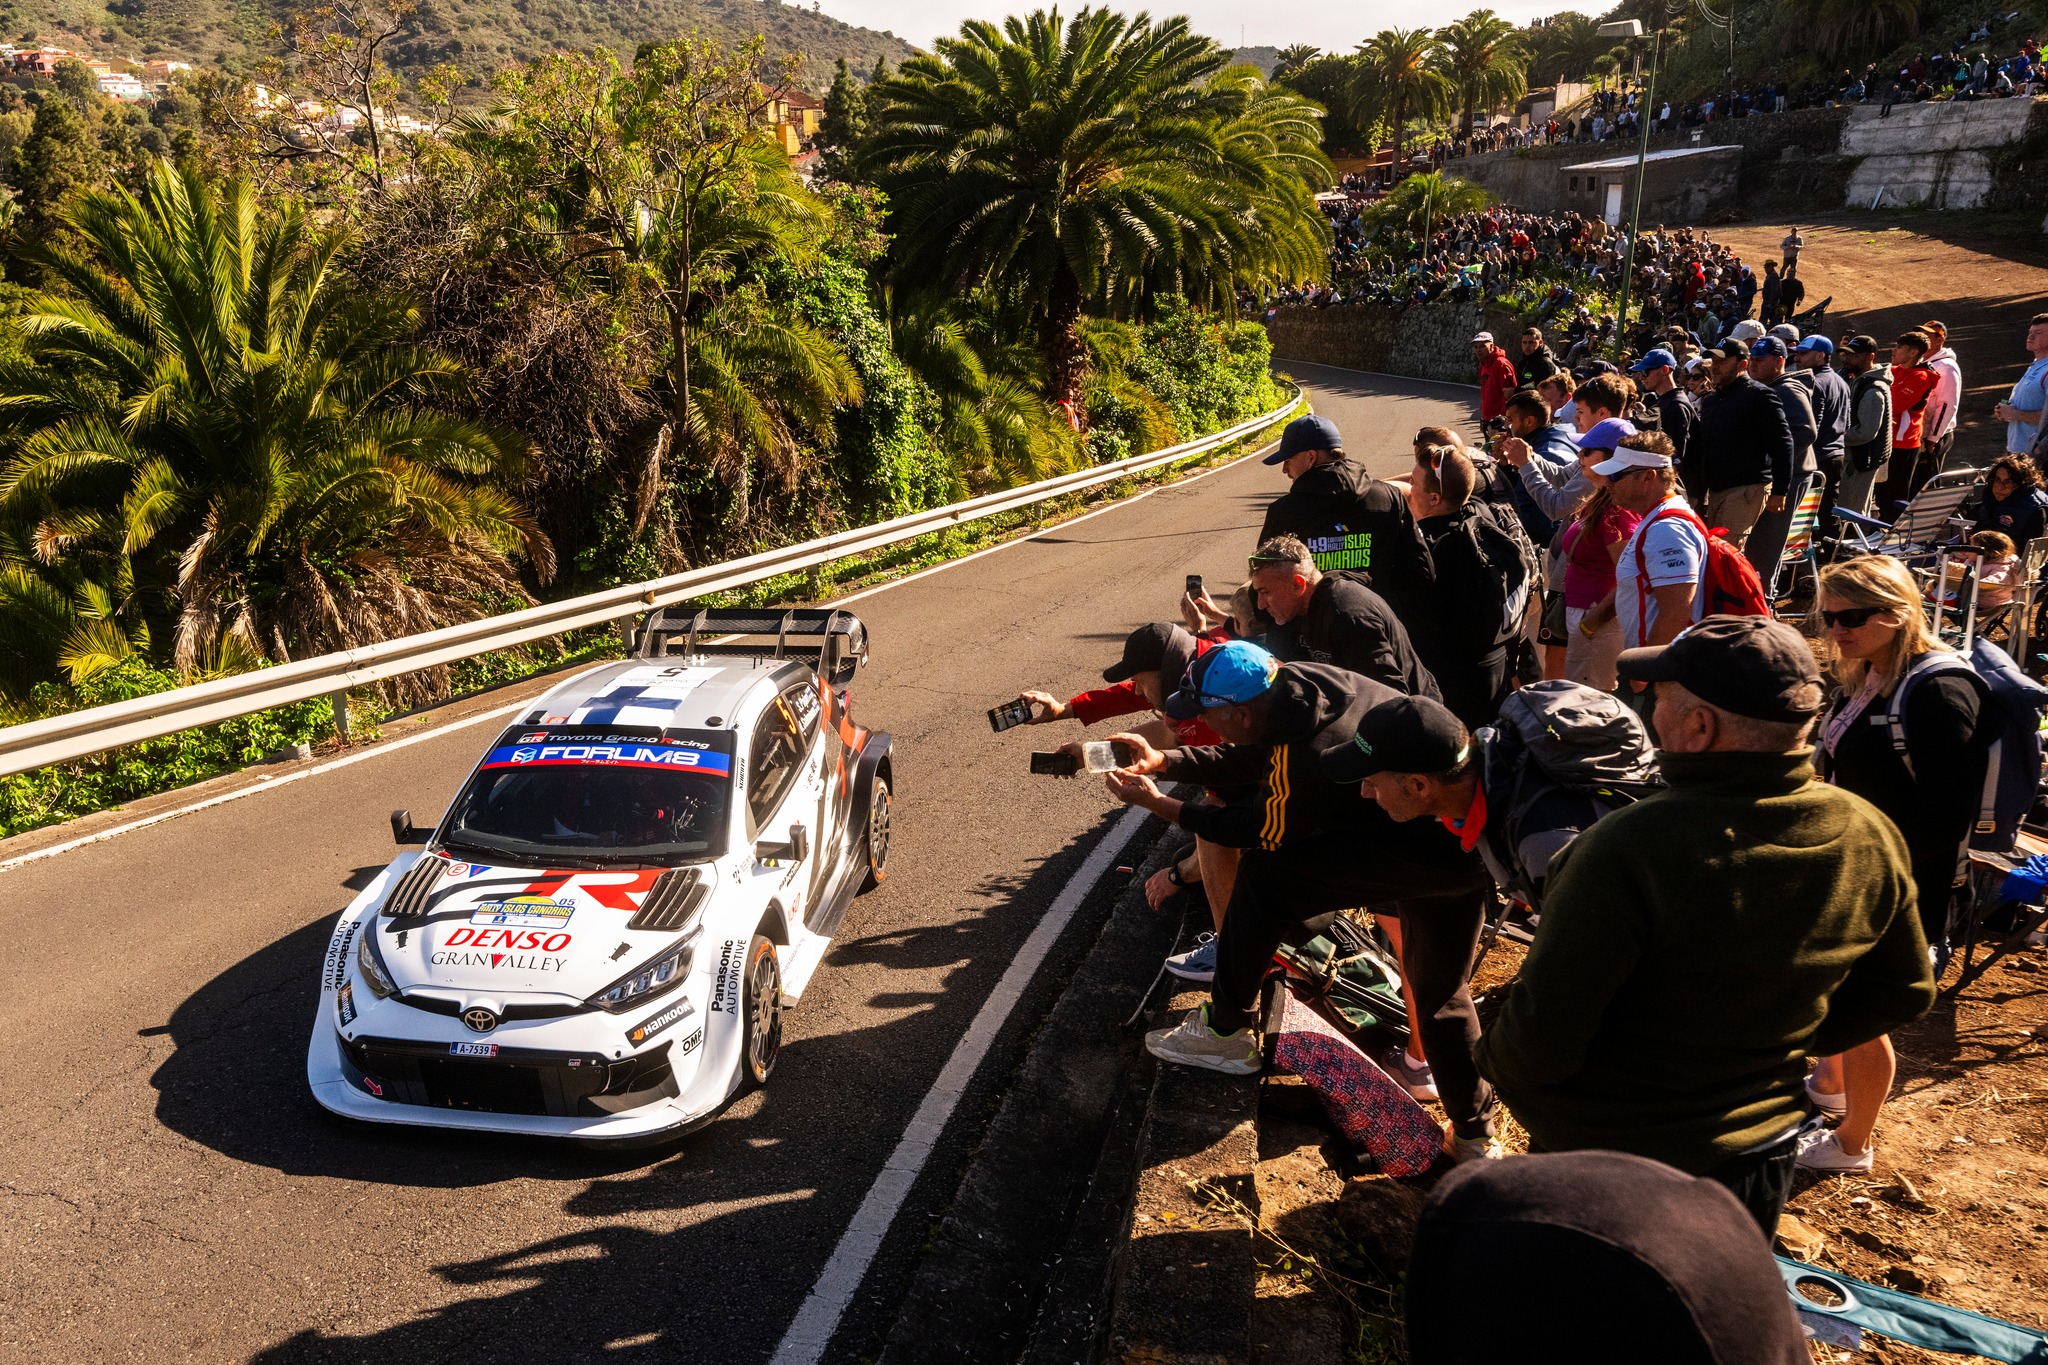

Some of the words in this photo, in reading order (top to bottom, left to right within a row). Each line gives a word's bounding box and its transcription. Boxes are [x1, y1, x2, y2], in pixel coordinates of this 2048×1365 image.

[1307, 537, 1328, 552] 49
[1327, 542, 1345, 551] RALLY
[1344, 533, 1372, 549] ISLAS
[656, 667, 688, 677] 5
[775, 697, 797, 735] 5
[548, 734, 602, 742] TOYOTA
[602, 734, 658, 744] GAZOO
[659, 737, 710, 750] Racing
[539, 746, 700, 766] FORUM8
[500, 904, 527, 914] ISLAS
[526, 905, 574, 917] CANARIAS
[558, 898, 576, 906] 05
[444, 928, 572, 952] DENSO
[324, 919, 349, 992] AUTOMOTIVE
[335, 921, 362, 990] Panasonic
[711, 939, 734, 1012] Panasonic
[726, 938, 747, 1015] AUTOMOTIVE
[459, 1044, 490, 1055] A-7539
[682, 1029, 703, 1052] OMP
